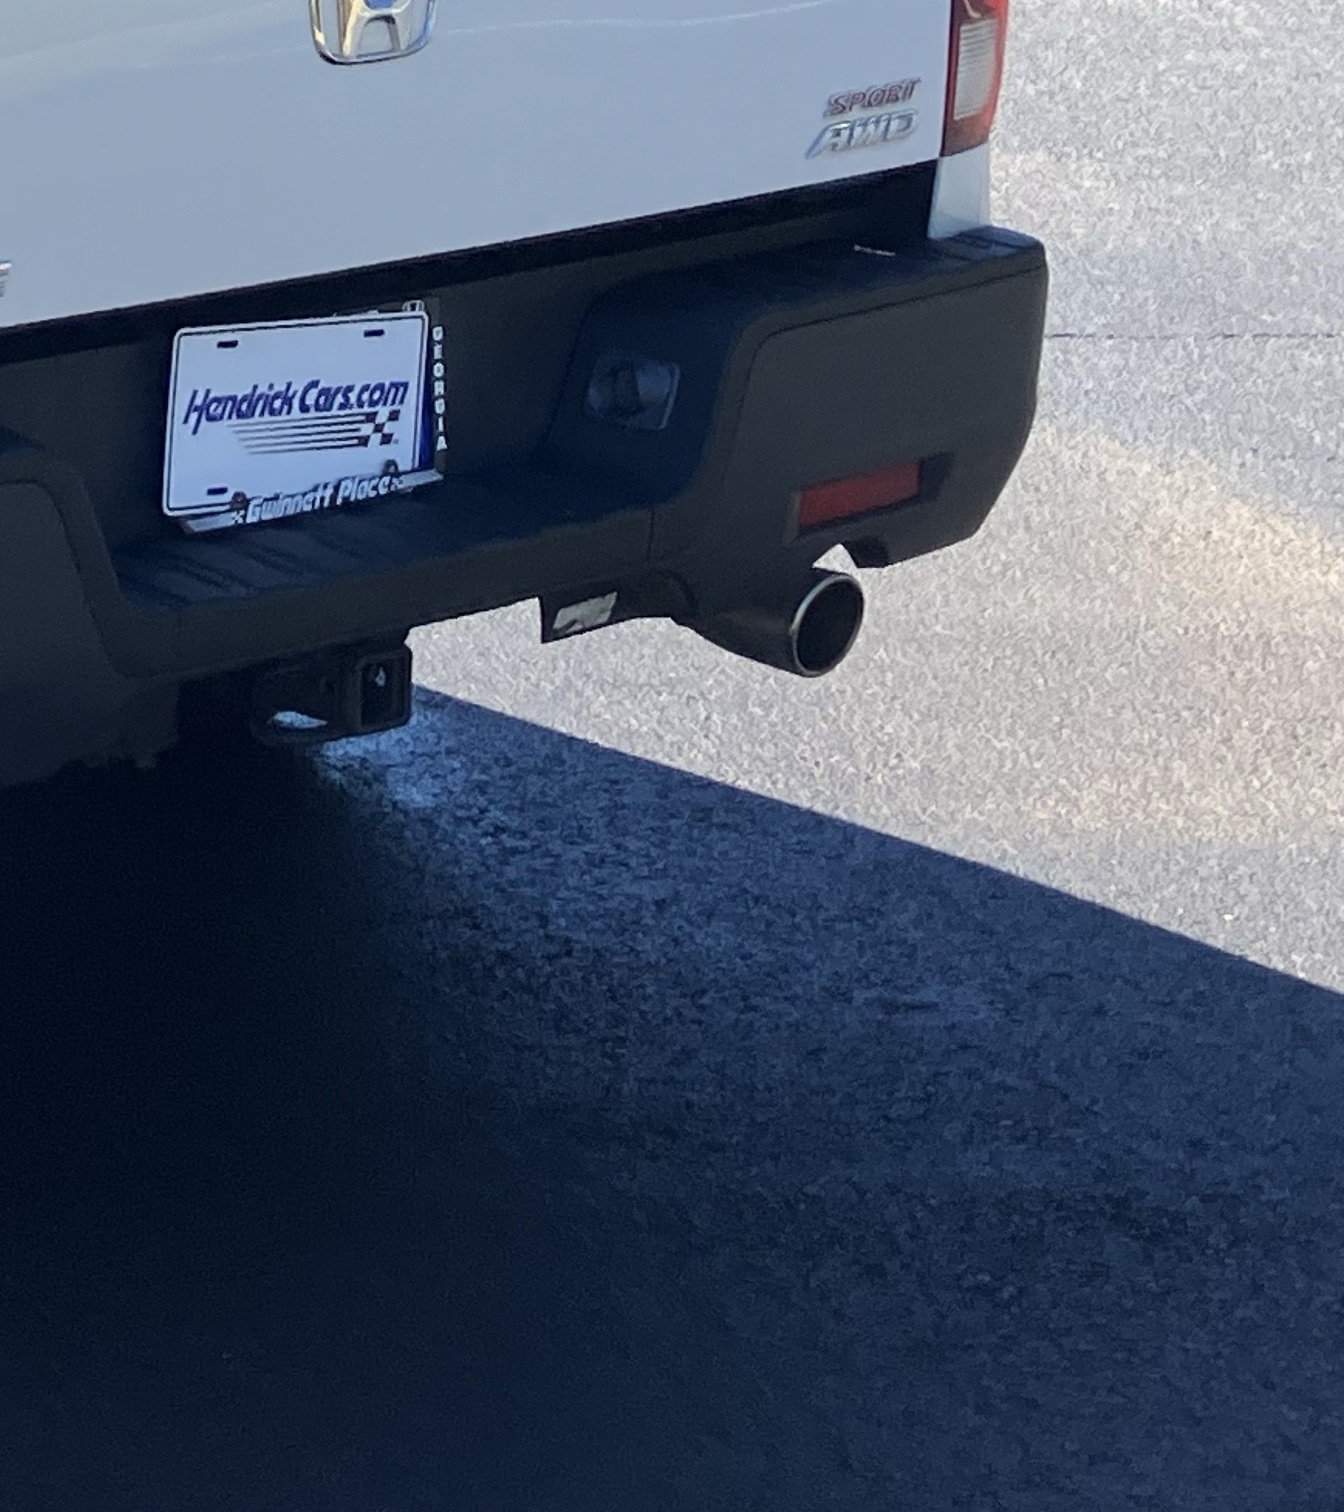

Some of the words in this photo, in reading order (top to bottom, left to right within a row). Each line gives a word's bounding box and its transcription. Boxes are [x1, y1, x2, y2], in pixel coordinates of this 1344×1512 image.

[823, 77, 921, 116] SPORT
[805, 108, 917, 159] AWD
[246, 482, 335, 524] Gwinnett
[336, 474, 391, 506] Place
